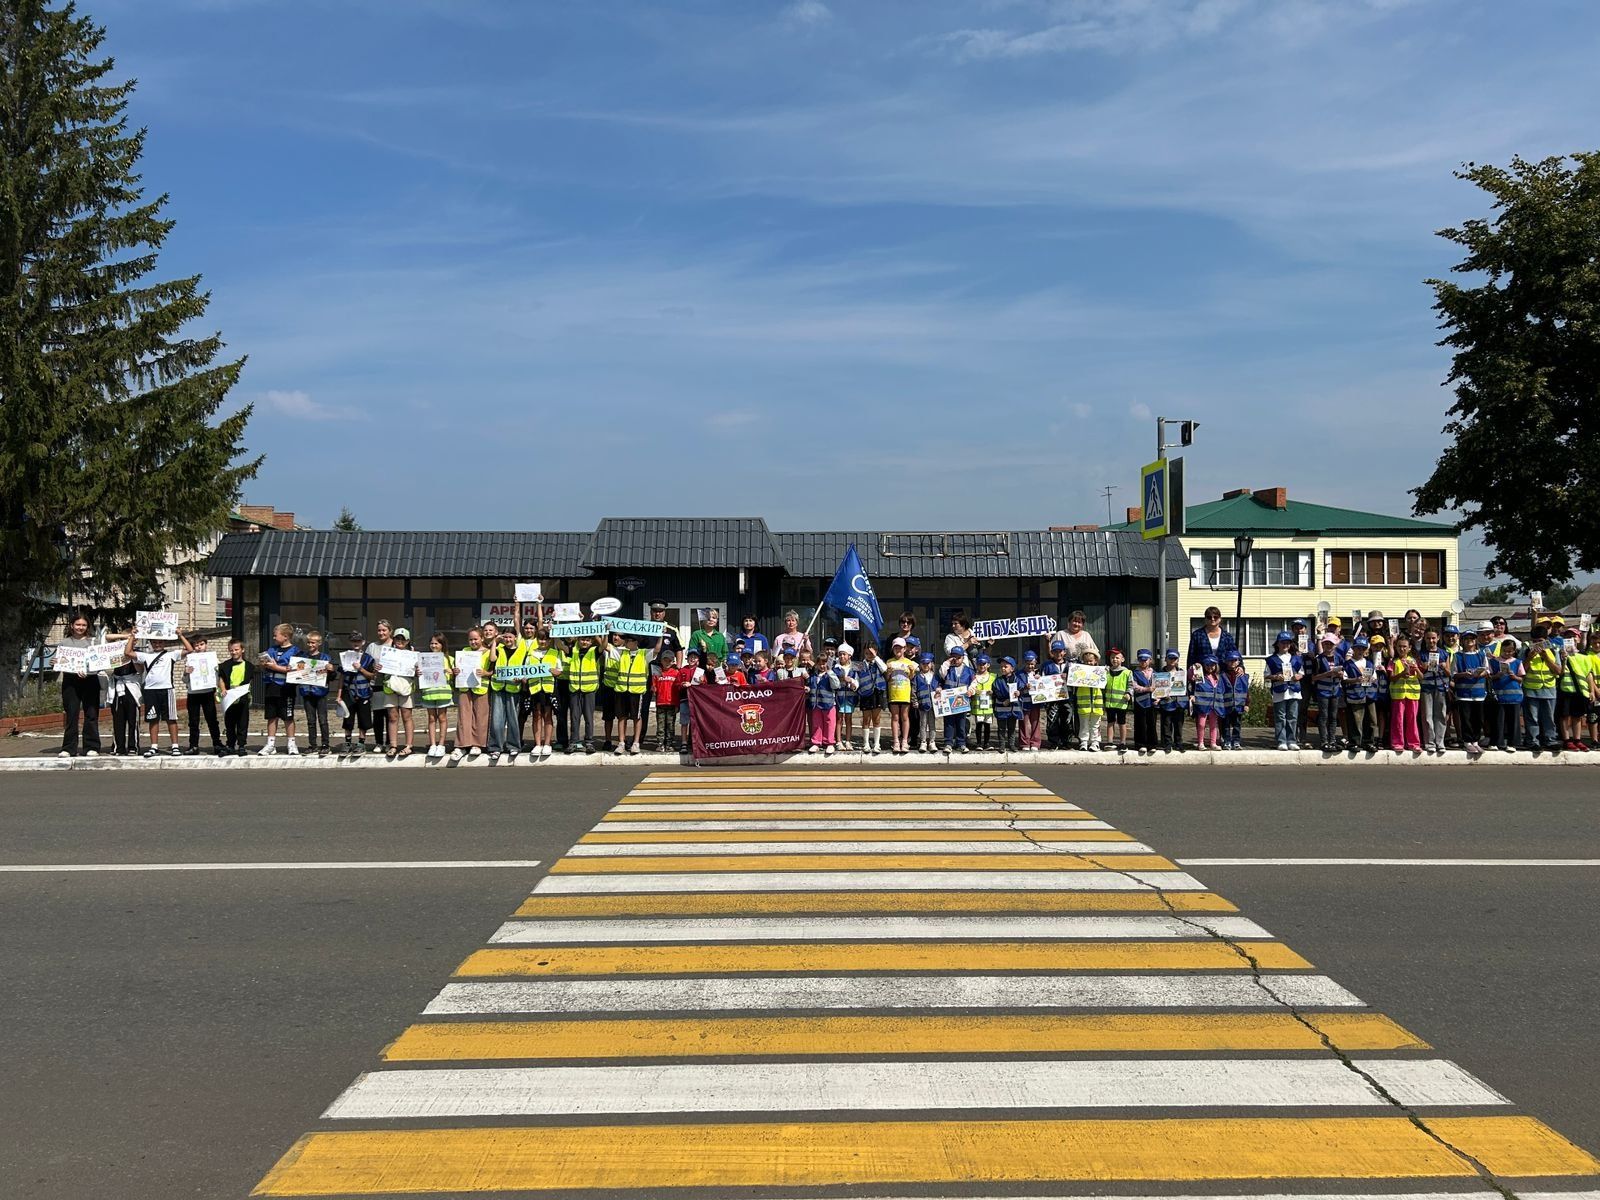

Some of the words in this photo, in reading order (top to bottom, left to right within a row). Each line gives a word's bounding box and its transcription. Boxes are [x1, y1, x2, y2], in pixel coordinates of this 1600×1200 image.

[551, 622, 608, 636] ГЛАВНЫЙ
[496, 665, 546, 678] РЕБЕНОК
[725, 689, 773, 701] ДОСААФ
[705, 739, 757, 750] РЕСПУБЛИКИ
[758, 735, 800, 745] ТАТАРСТАН
